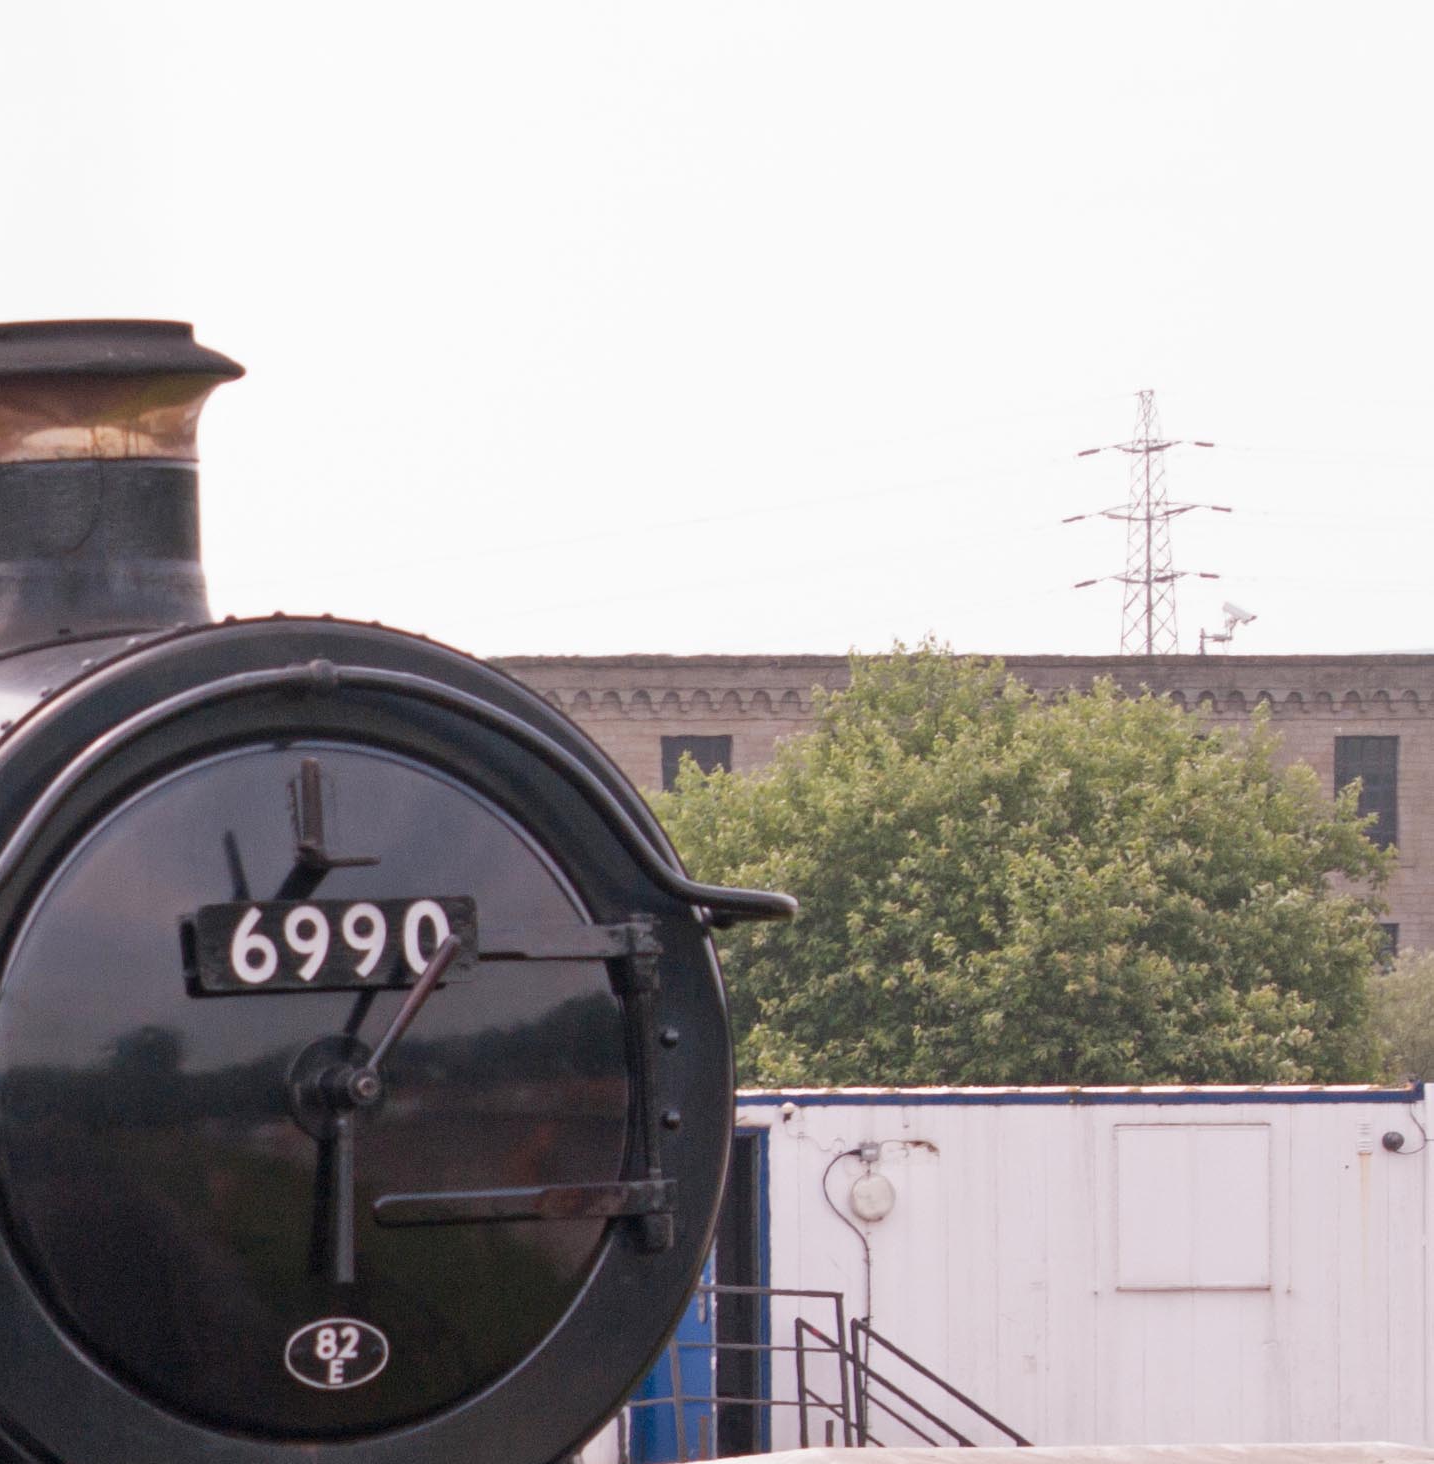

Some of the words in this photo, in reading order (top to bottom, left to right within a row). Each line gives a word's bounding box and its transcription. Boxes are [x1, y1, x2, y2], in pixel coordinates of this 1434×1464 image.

[231, 899, 451, 984] 6990
[316, 1326, 360, 1360] 82
[329, 1358, 344, 1384] E
